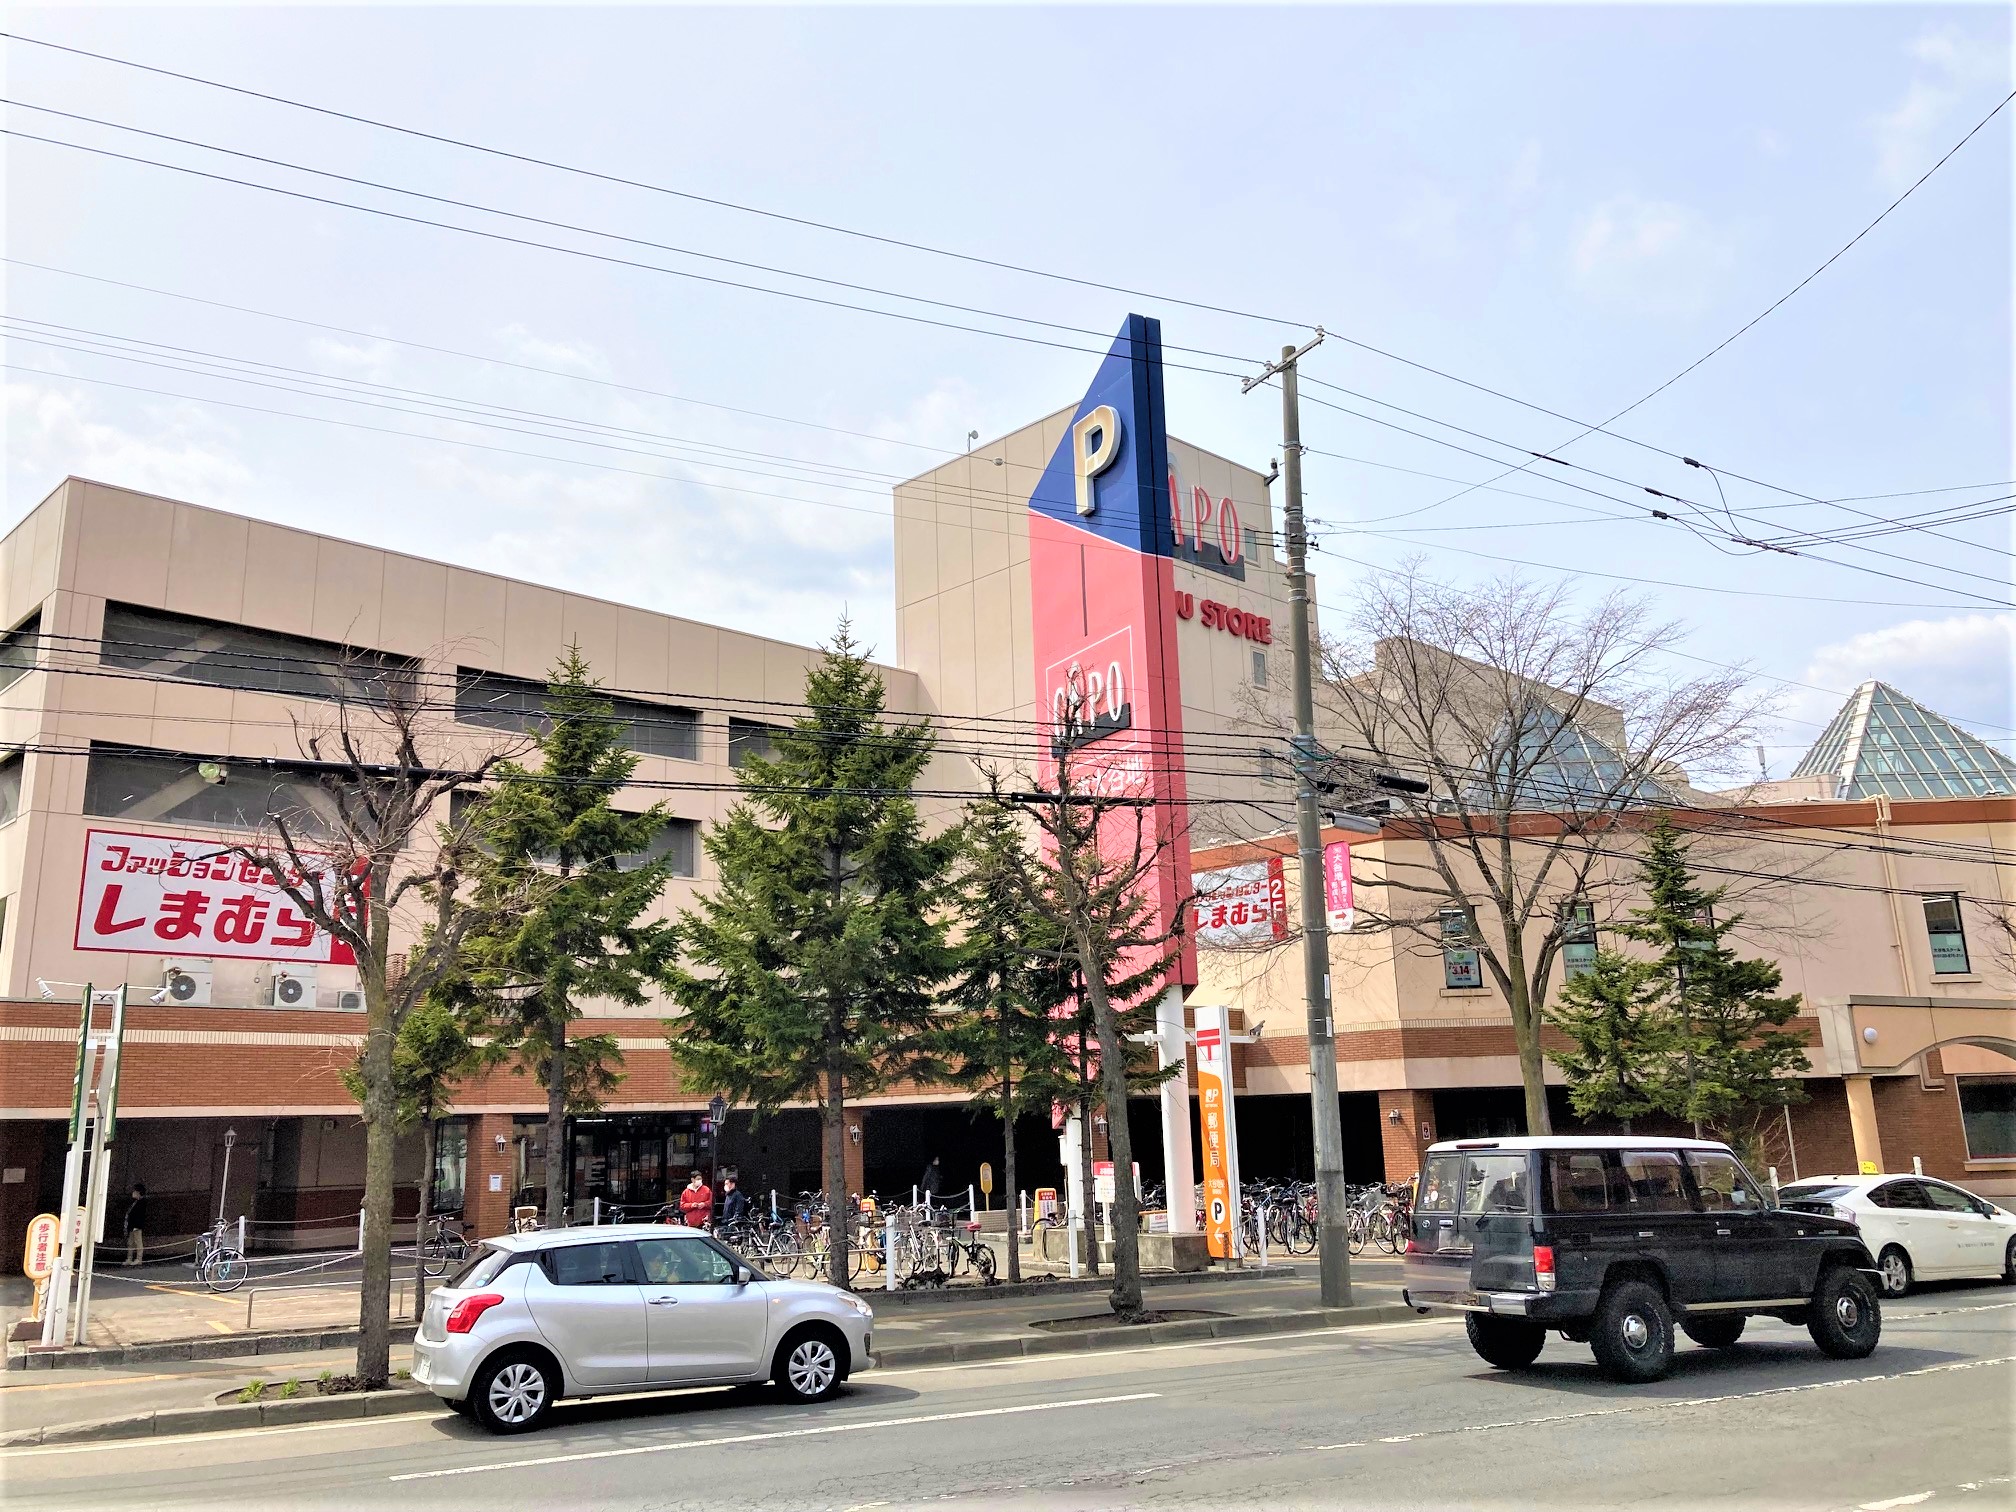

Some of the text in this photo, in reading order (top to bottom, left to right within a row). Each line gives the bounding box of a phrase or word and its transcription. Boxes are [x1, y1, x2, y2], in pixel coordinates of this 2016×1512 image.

[1073, 404, 1122, 516] P
[1200, 598, 1272, 645] STORE
[94, 884, 316, 947] しまむら
[1193, 898, 1269, 930] しまむら
[1207, 1112, 1220, 1168] 郵便局
[1215, 1202, 1222, 1220] P
[35, 1223, 50, 1271] 歩行者注意
